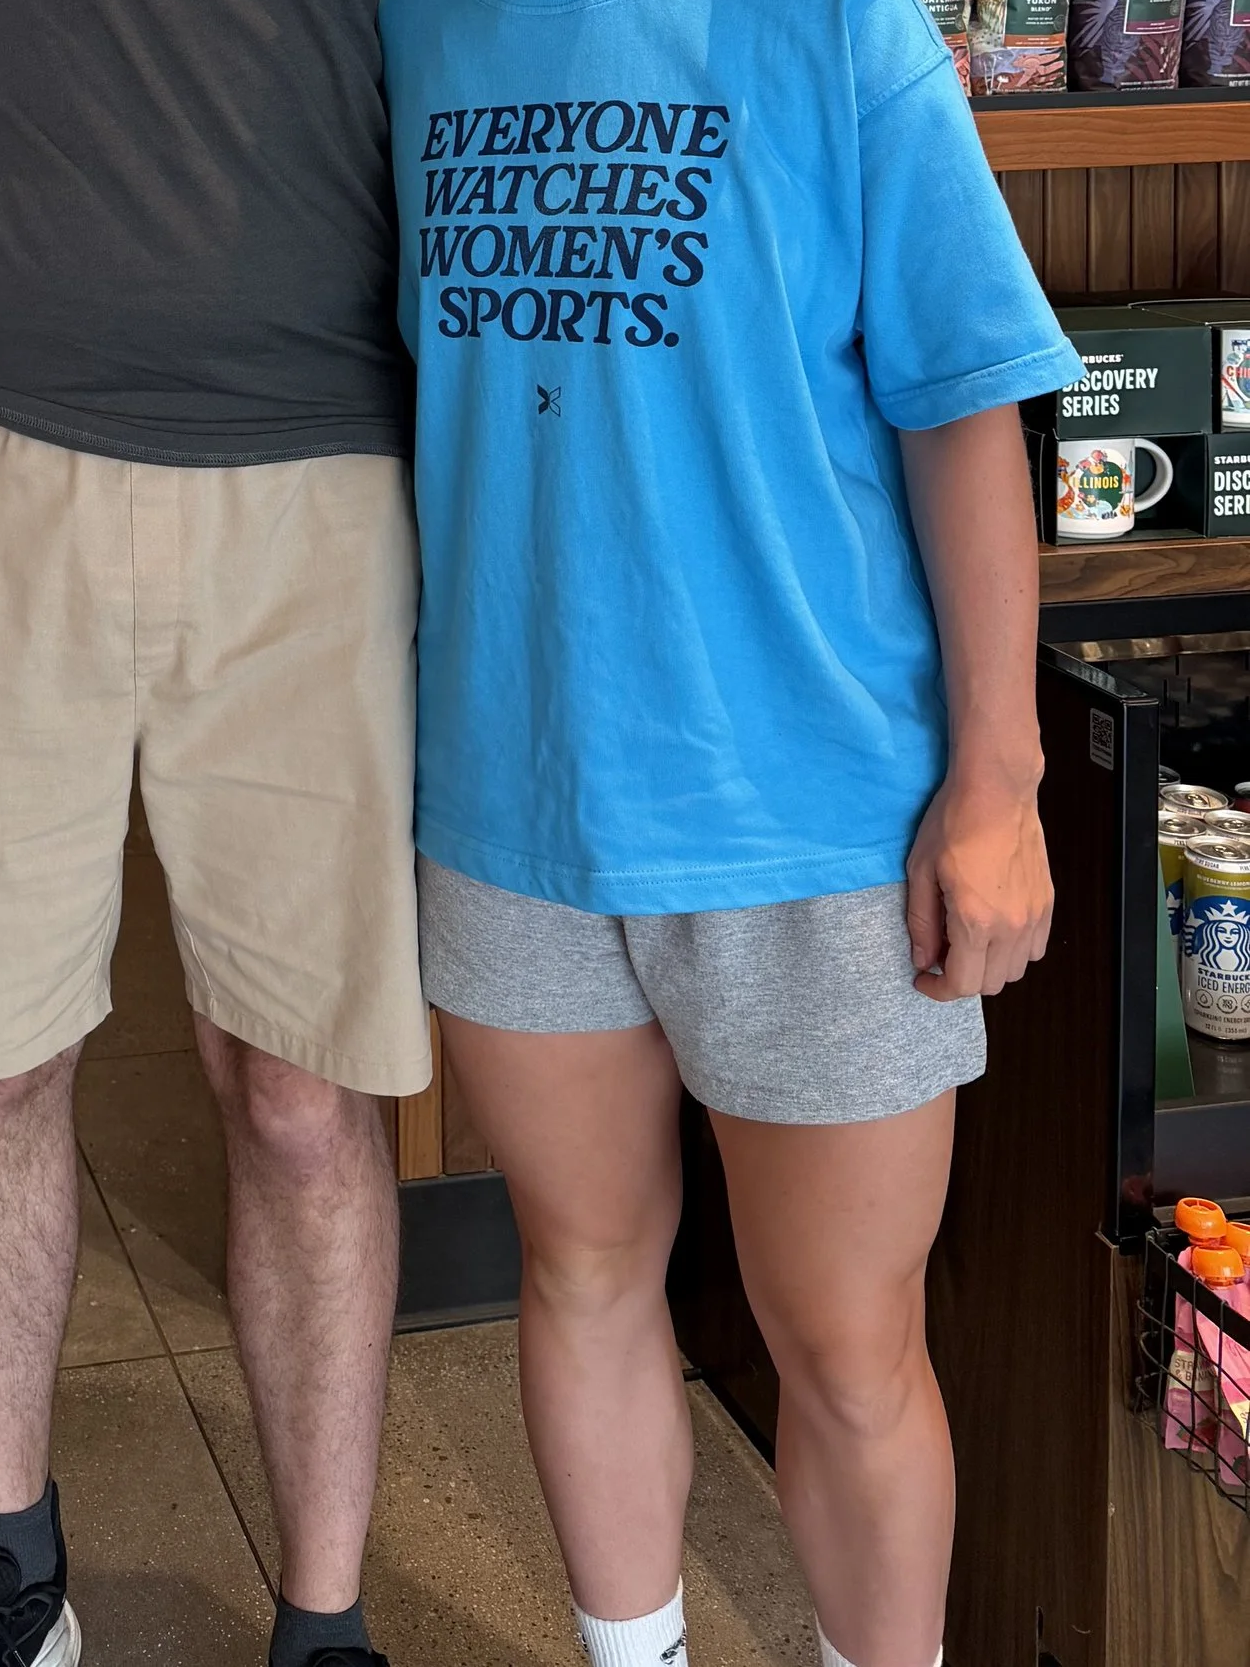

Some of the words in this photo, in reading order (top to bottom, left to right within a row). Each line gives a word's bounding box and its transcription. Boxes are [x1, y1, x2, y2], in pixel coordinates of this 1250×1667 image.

[928, 4, 958, 13] NTIGUA
[421, 100, 730, 163] EVERYONE
[425, 163, 712, 221] WATCHES
[419, 224, 709, 287] WOMEN'S
[438, 286, 680, 348] SPORTS.
[1081, 354, 1122, 364] RBUCKS
[1062, 394, 1120, 417] SERIES
[1073, 476, 1119, 489] ILLINOIS
[1204, 860, 1220, 869] SUGAR
[1197, 975, 1219, 992] ICED
